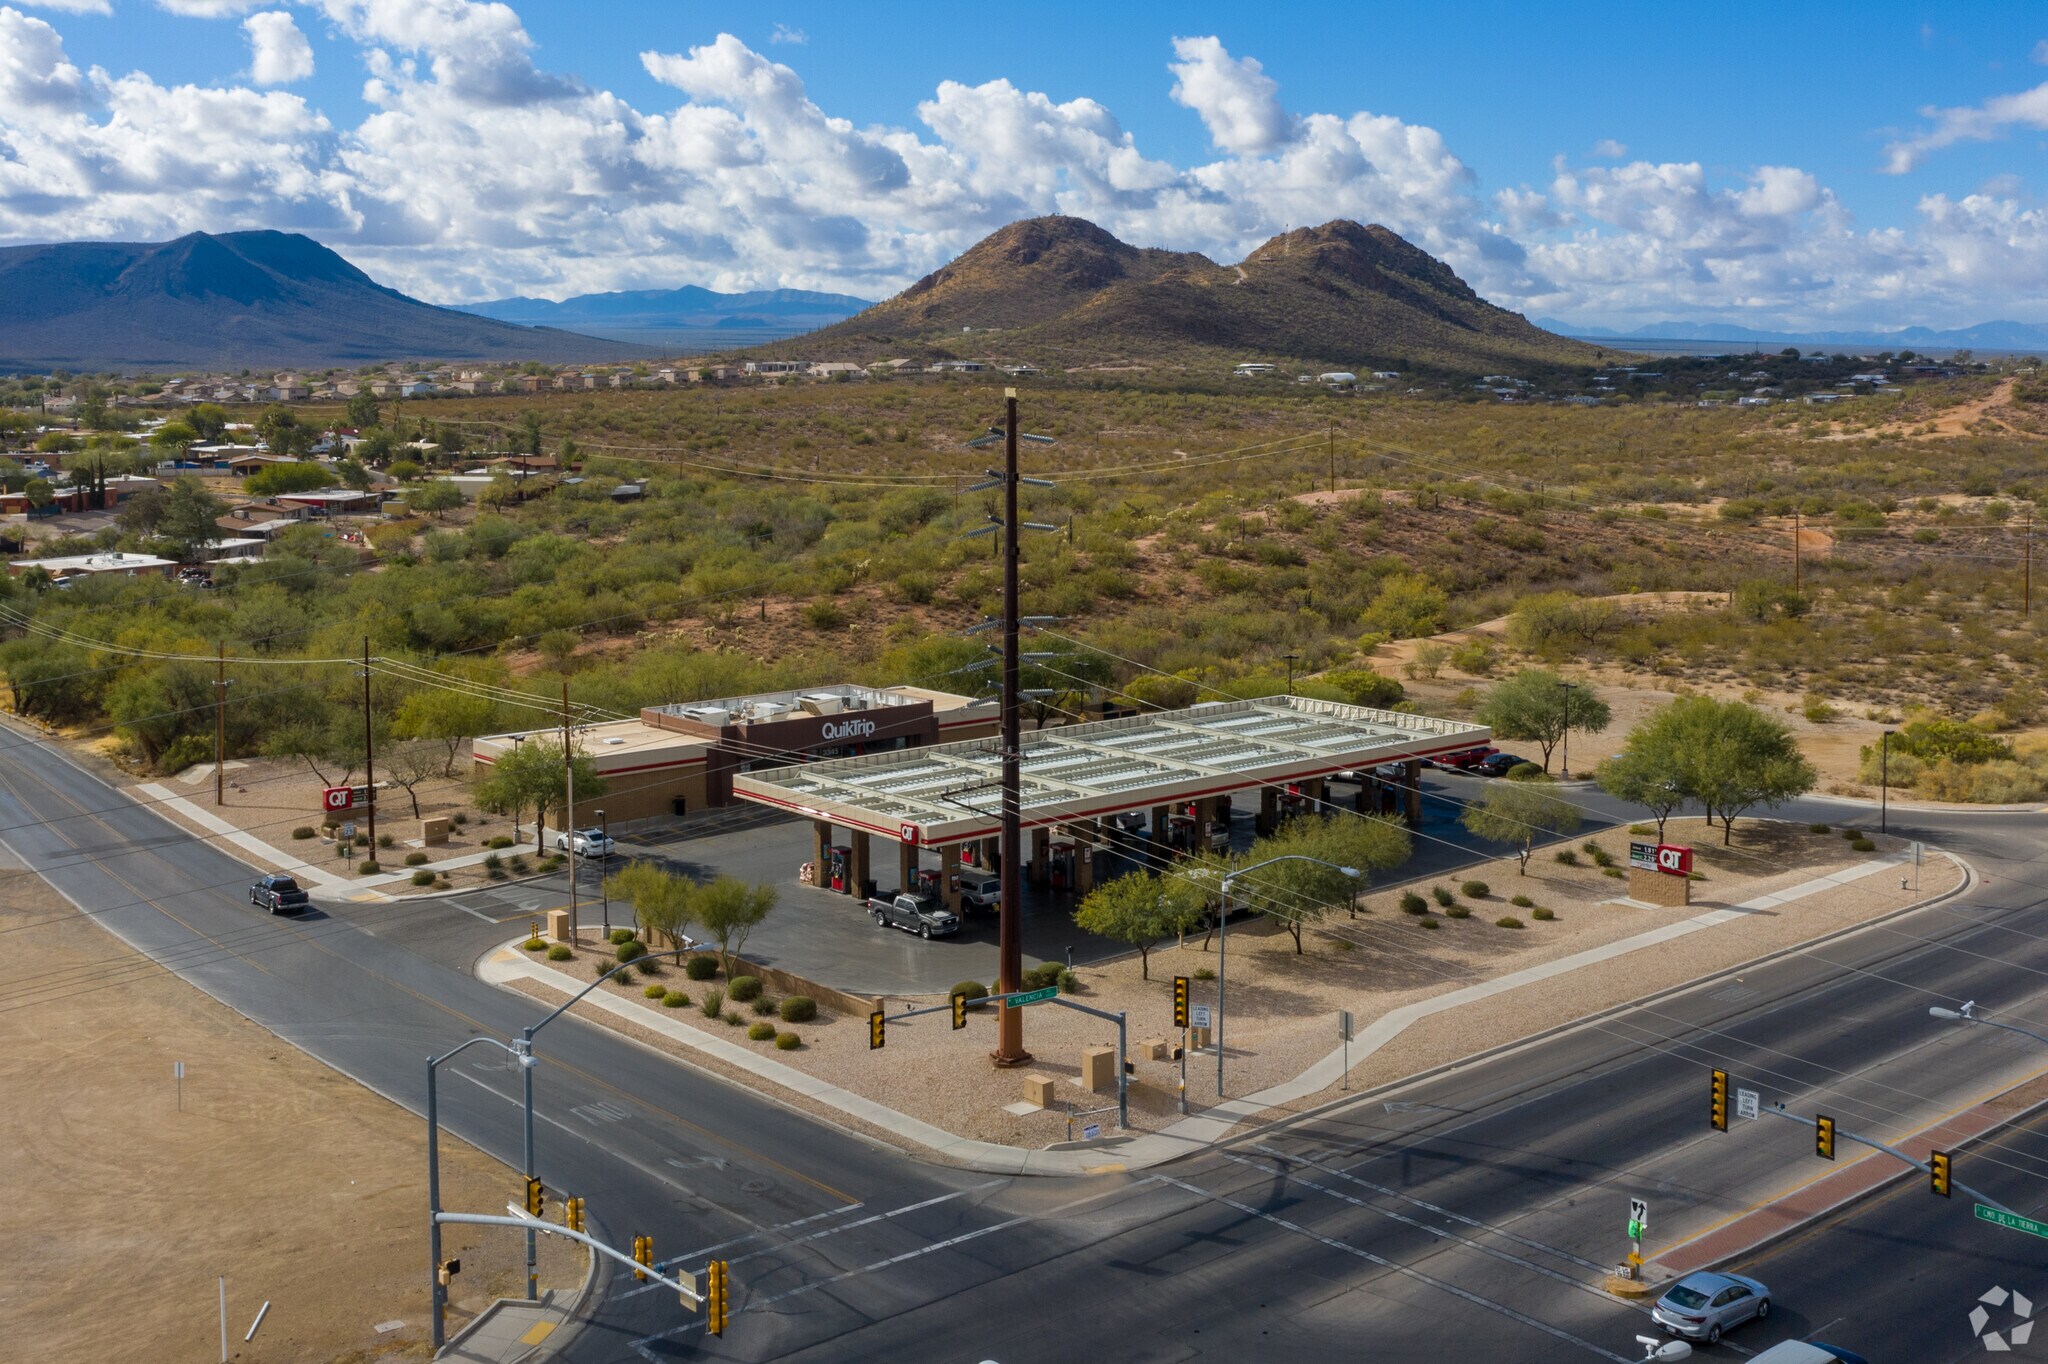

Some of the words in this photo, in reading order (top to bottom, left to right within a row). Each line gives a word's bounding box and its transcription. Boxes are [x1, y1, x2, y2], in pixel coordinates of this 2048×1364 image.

[822, 719, 875, 739] QuikTrip
[329, 791, 348, 806] QT
[902, 826, 913, 840] QT
[1659, 849, 1681, 870] QT
[1015, 993, 1043, 1004] VALENCIA
[1740, 1091, 1757, 1100] LEADING
[1740, 1110, 1755, 1118] ARROW
[1983, 1209, 1995, 1220] CMO
[1999, 1214, 2006, 1224] DE
[2008, 1216, 2016, 1226] LA
[2018, 1219, 2039, 1232] TIERRA
